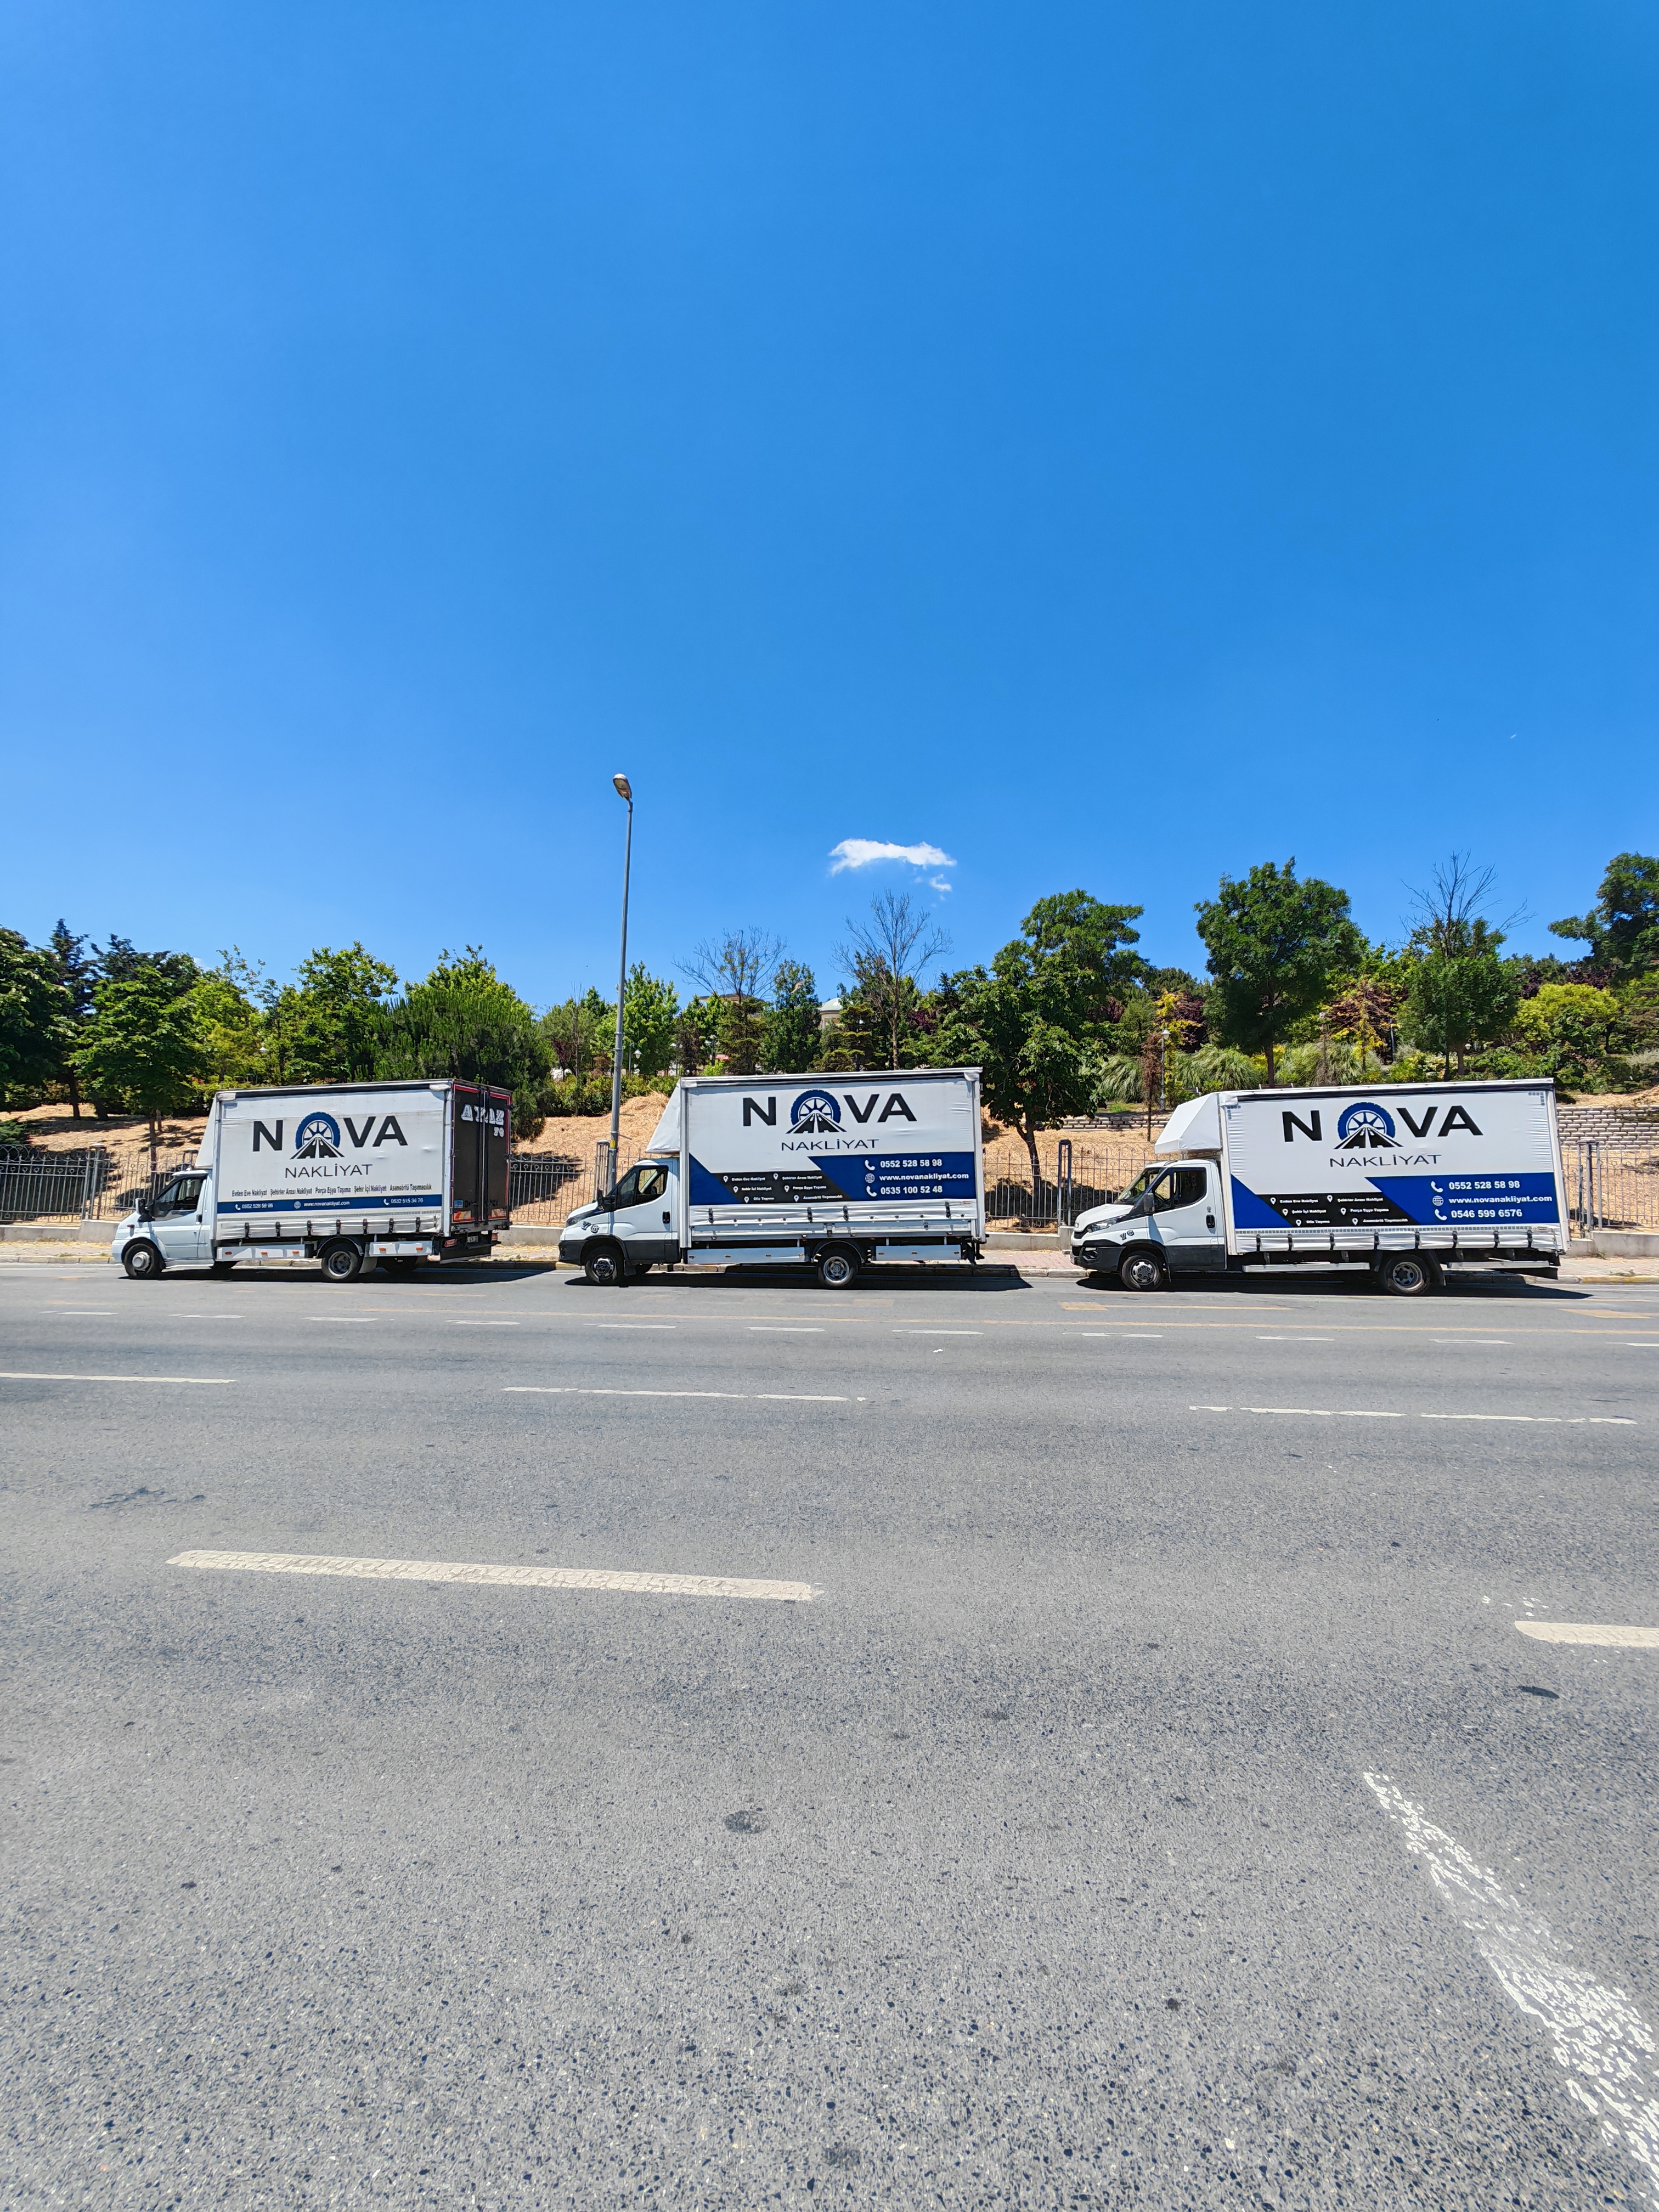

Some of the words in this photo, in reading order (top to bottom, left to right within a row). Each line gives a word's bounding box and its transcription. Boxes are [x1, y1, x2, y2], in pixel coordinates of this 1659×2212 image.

[743, 1088, 917, 1133] NOVA
[1282, 1102, 1483, 1150] NOVA
[253, 1111, 408, 1159] NOVA
[781, 1138, 880, 1152] NAKLİYAT
[880, 1160, 900, 1168] 0552
[902, 1159, 918, 1167] 528
[1330, 1154, 1442, 1168] NAKLİYAT
[285, 1164, 373, 1179] NAKLİYAT
[879, 1172, 969, 1181] www.novanakliyat.com
[880, 1187, 901, 1195] 0535
[1449, 1181, 1472, 1190] 0552
[1474, 1181, 1492, 1189] 528
[1494, 1181, 1506, 1189] 58
[1508, 1180, 1520, 1188] 98
[1448, 1195, 1553, 1204] www.novanakliyat.com
[1451, 1210, 1475, 1218] 0546
[1477, 1209, 1496, 1218] 599
[1498, 1209, 1522, 1217] 6576
